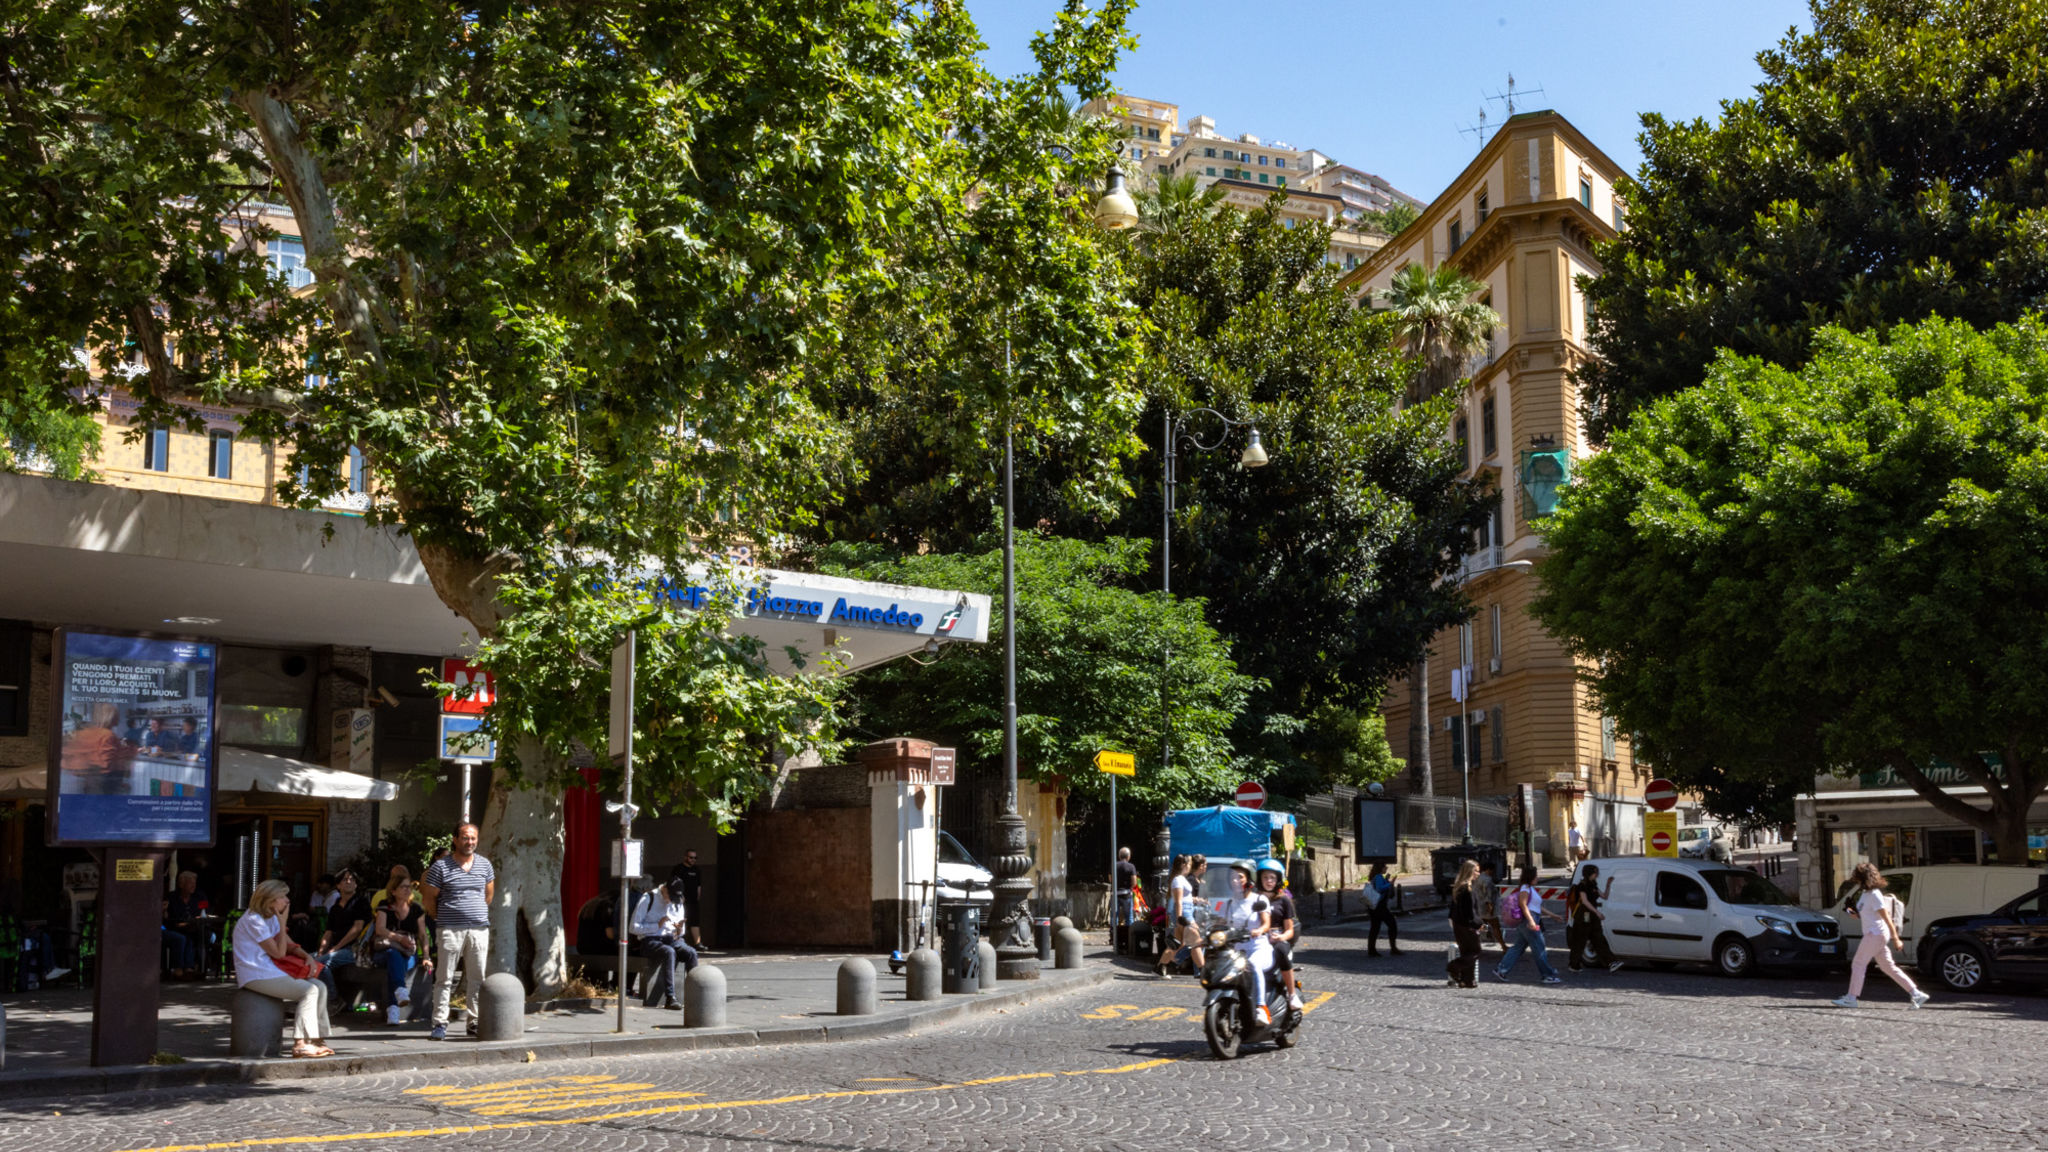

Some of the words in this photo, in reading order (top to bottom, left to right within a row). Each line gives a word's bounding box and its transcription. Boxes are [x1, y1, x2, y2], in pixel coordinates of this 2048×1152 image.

[750, 587, 823, 616] Piazza
[832, 598, 924, 627] Amedeo
[72, 662, 107, 671] QUANDO
[114, 665, 133, 673] TUOI
[72, 670, 113, 678] VENGONO
[114, 672, 151, 681] PREMIATI
[100, 687, 140, 695] BUSINESS
[142, 688, 150, 696] SI
[452, 671, 488, 702] M
